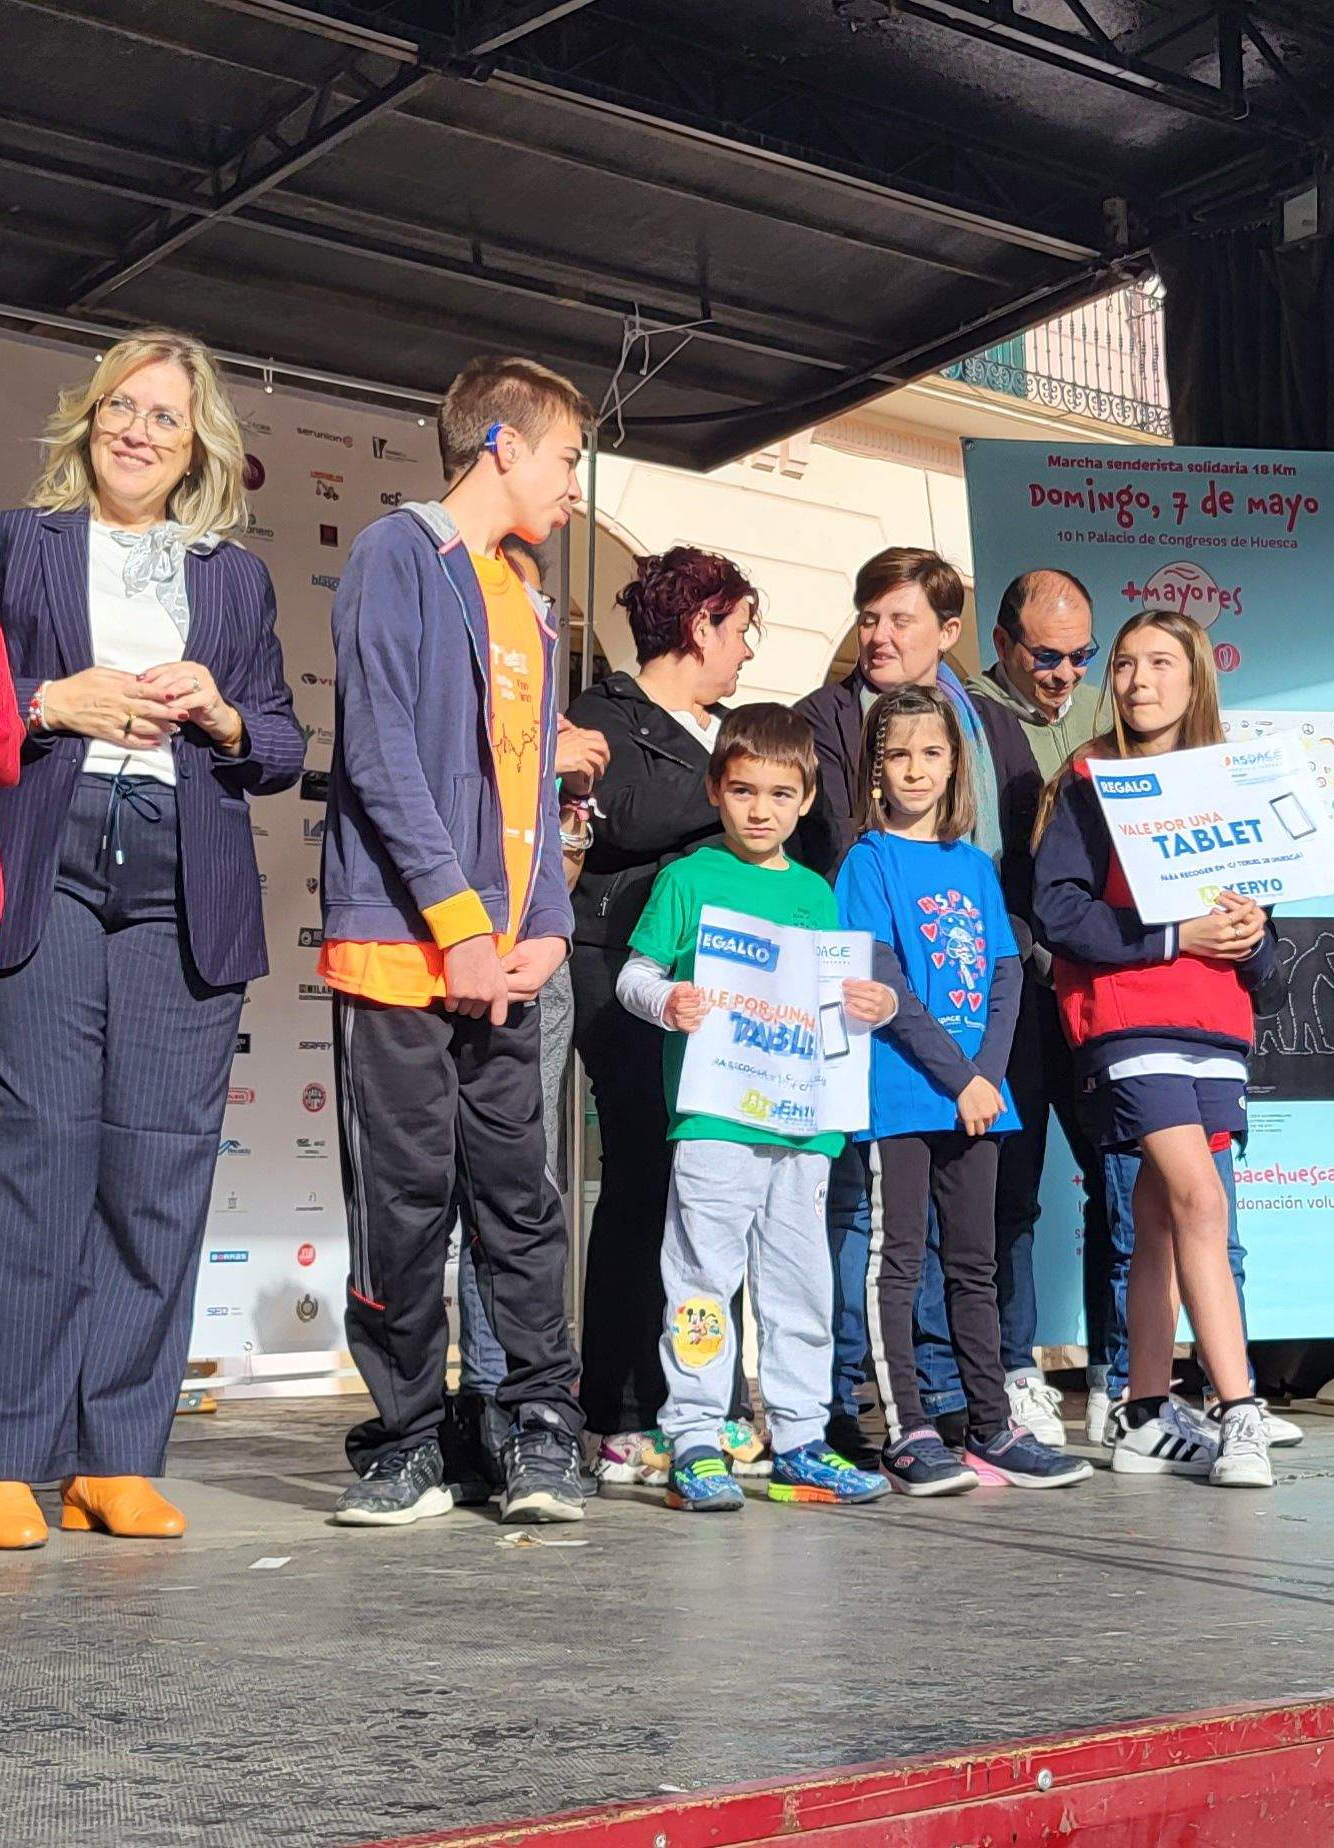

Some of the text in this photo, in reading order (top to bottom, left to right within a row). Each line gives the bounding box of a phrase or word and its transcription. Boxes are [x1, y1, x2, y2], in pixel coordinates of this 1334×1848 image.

[1047, 454, 1297, 477] Marcha senderista solidaria 18 Km
[380, 491, 403, 508] acf
[1028, 477, 1320, 533] Domingo, 7 de mayo
[1057, 530, 1299, 550] 10 h Palacio de Congresos de Huesca
[1099, 778, 1152, 794] REGALO
[1118, 810, 1224, 836] VALE POR UNA
[1151, 818, 1264, 860] TABLET
[1160, 873, 1179, 882] PARA
[1236, 1194, 1303, 1211] donación
